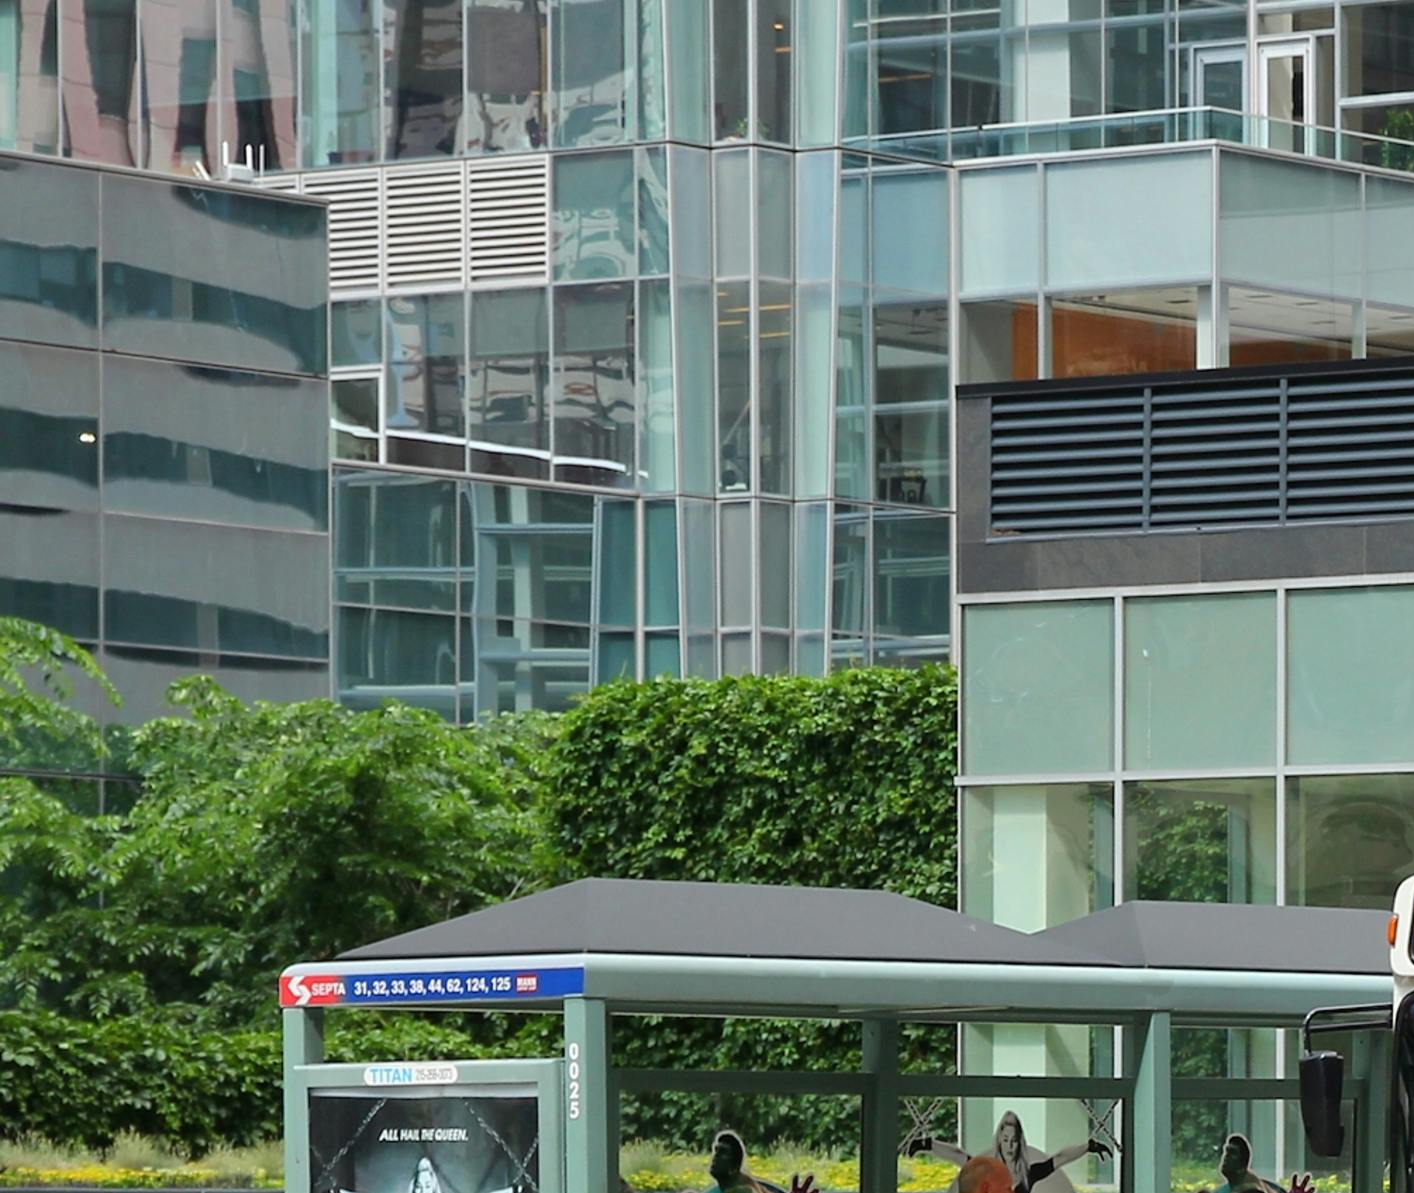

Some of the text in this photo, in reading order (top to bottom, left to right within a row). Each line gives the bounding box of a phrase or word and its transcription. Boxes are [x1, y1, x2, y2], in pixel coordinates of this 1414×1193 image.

[311, 981, 346, 997] SEPTA
[354, 982, 371, 998] 31,
[372, 981, 390, 997] 32,
[391, 980, 408, 996] 33,
[409, 979, 427, 995] 38,
[428, 979, 445, 995] 44,
[447, 978, 464, 994] 62,
[466, 977, 489, 993] 124,
[491, 977, 511, 991] 125
[369, 1068, 412, 1083] TITAN
[569, 1042, 579, 1119] 0025
[379, 1128, 398, 1141] ALL
[400, 1128, 420, 1141] HAIL
[434, 1127, 469, 1141] QUEEN.
